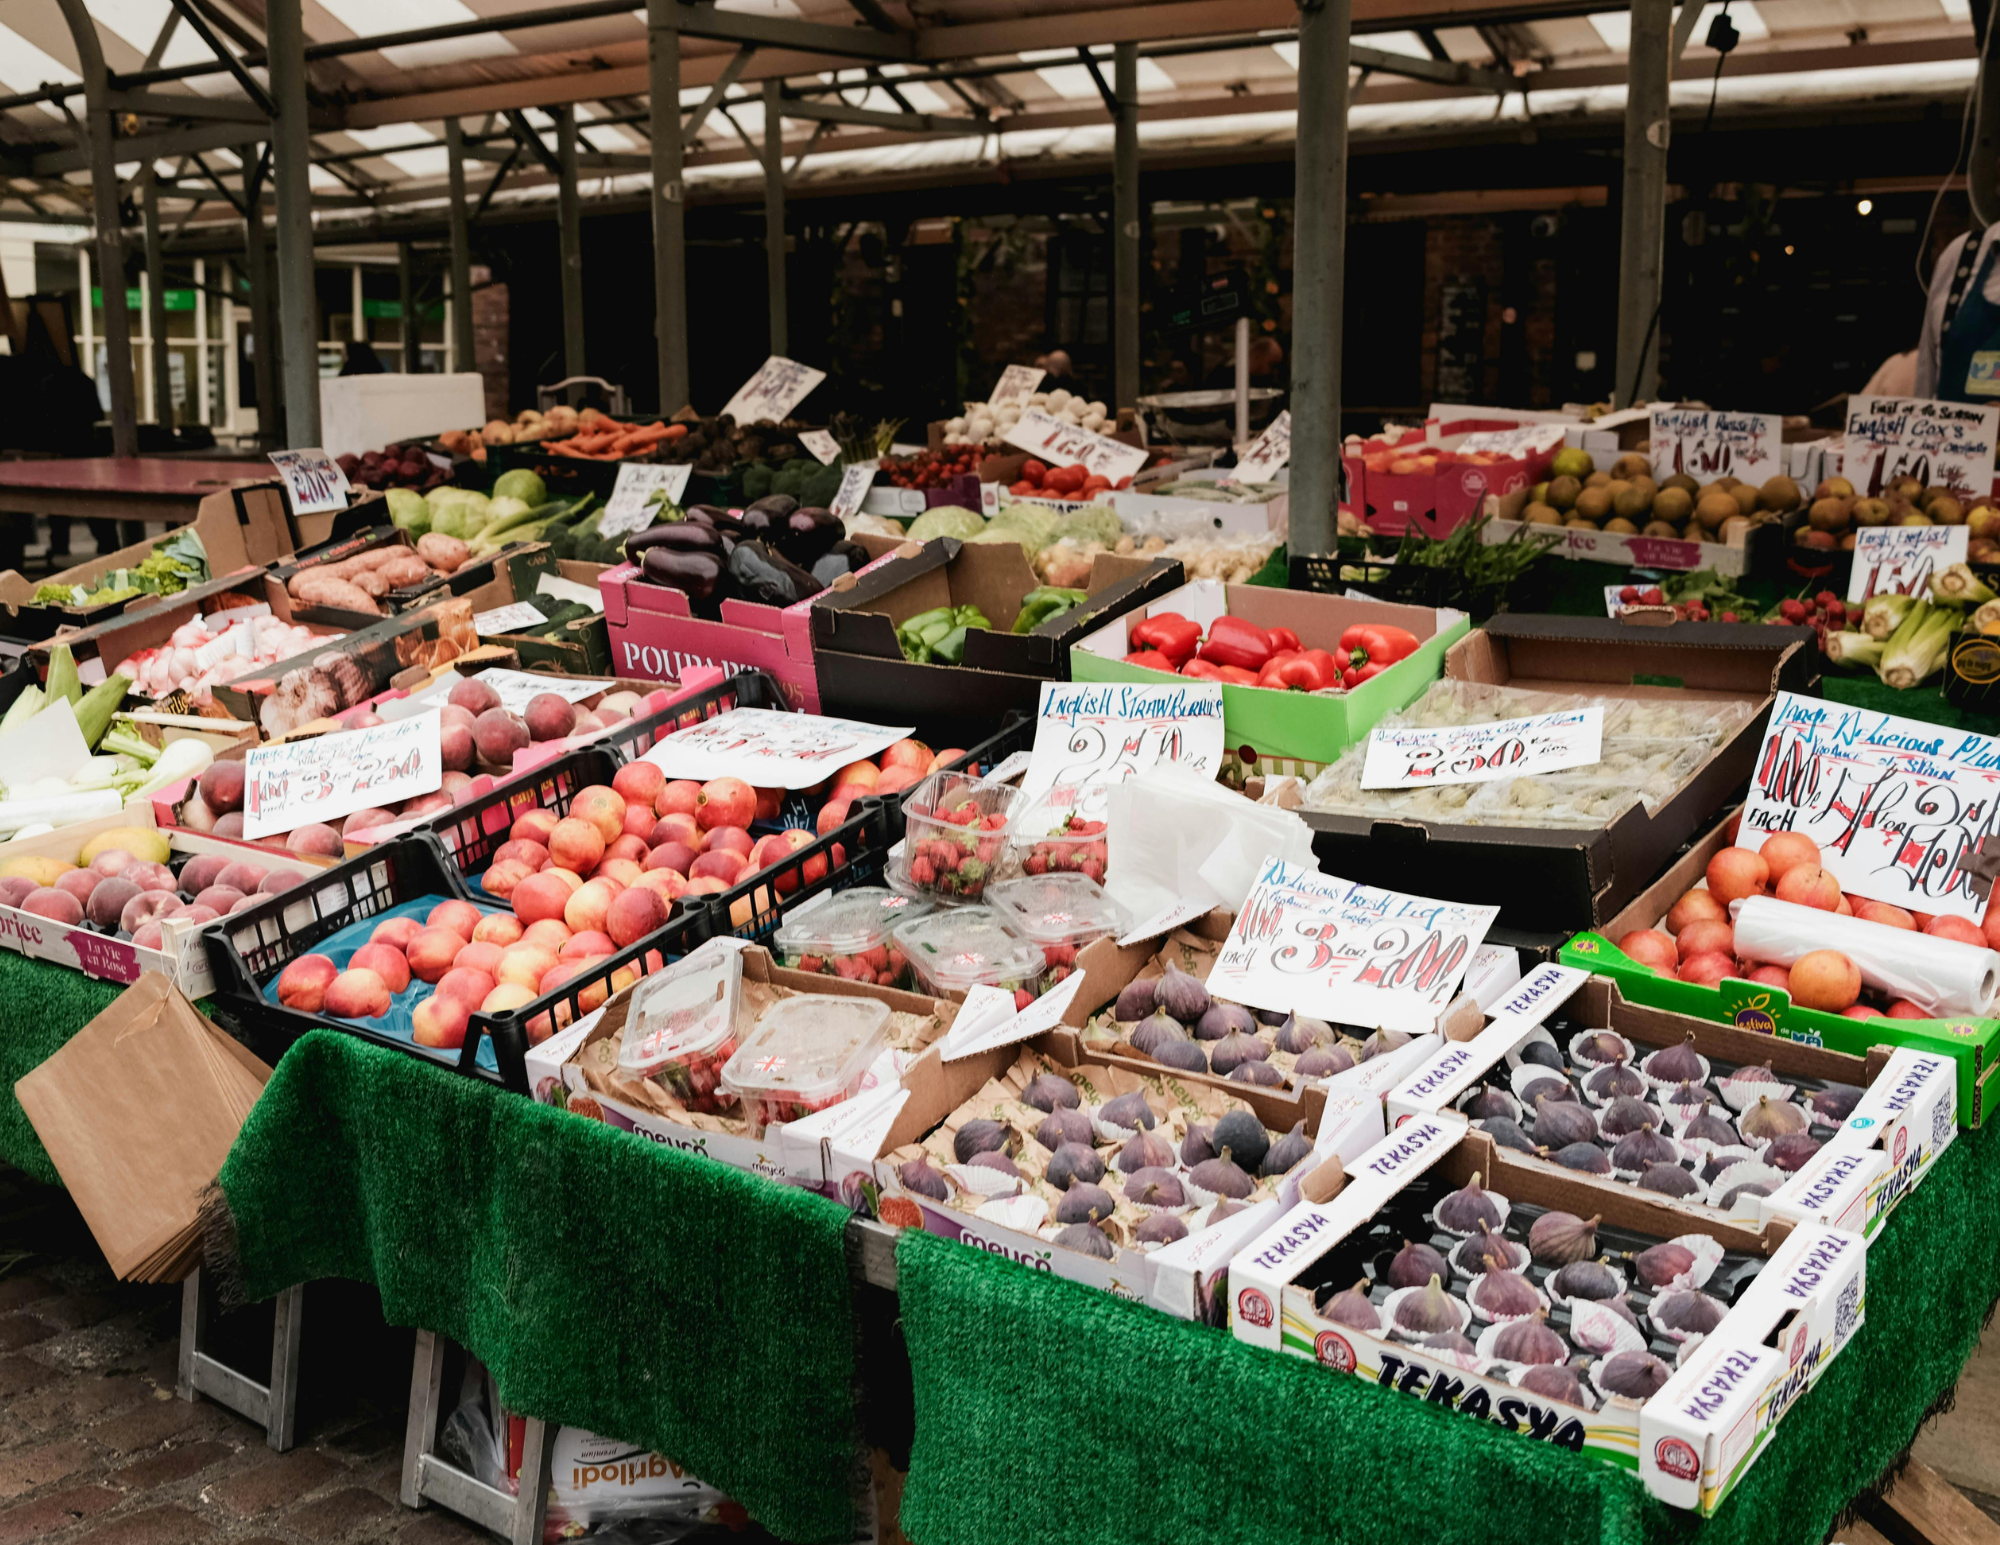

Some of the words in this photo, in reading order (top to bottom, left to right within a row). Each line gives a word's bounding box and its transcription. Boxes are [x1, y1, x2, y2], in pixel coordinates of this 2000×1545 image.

[86, 938, 102, 955] La
[102, 943, 122, 961] Vie
[86, 953, 101, 966] en
[102, 958, 128, 976] Rose
[1505, 968, 1566, 1017] TEKASYA
[1406, 1049, 1475, 1099] TEKASYA
[1884, 1058, 1941, 1112] TEKASYA
[1368, 1123, 1443, 1176] TEKASYA
[1798, 1155, 1865, 1210] TEKASYA
[1875, 1143, 1923, 1219] TEKASYA
[1252, 1213, 1332, 1270] TEKASYA
[1781, 1234, 1851, 1299] TEKASYA
[1377, 1350, 1587, 1453] TEKASYA
[1682, 1350, 1762, 1422] TEKASYA
[1766, 1338, 1823, 1427] TEKASYA
[572, 1453, 687, 1491] Agrilodi
